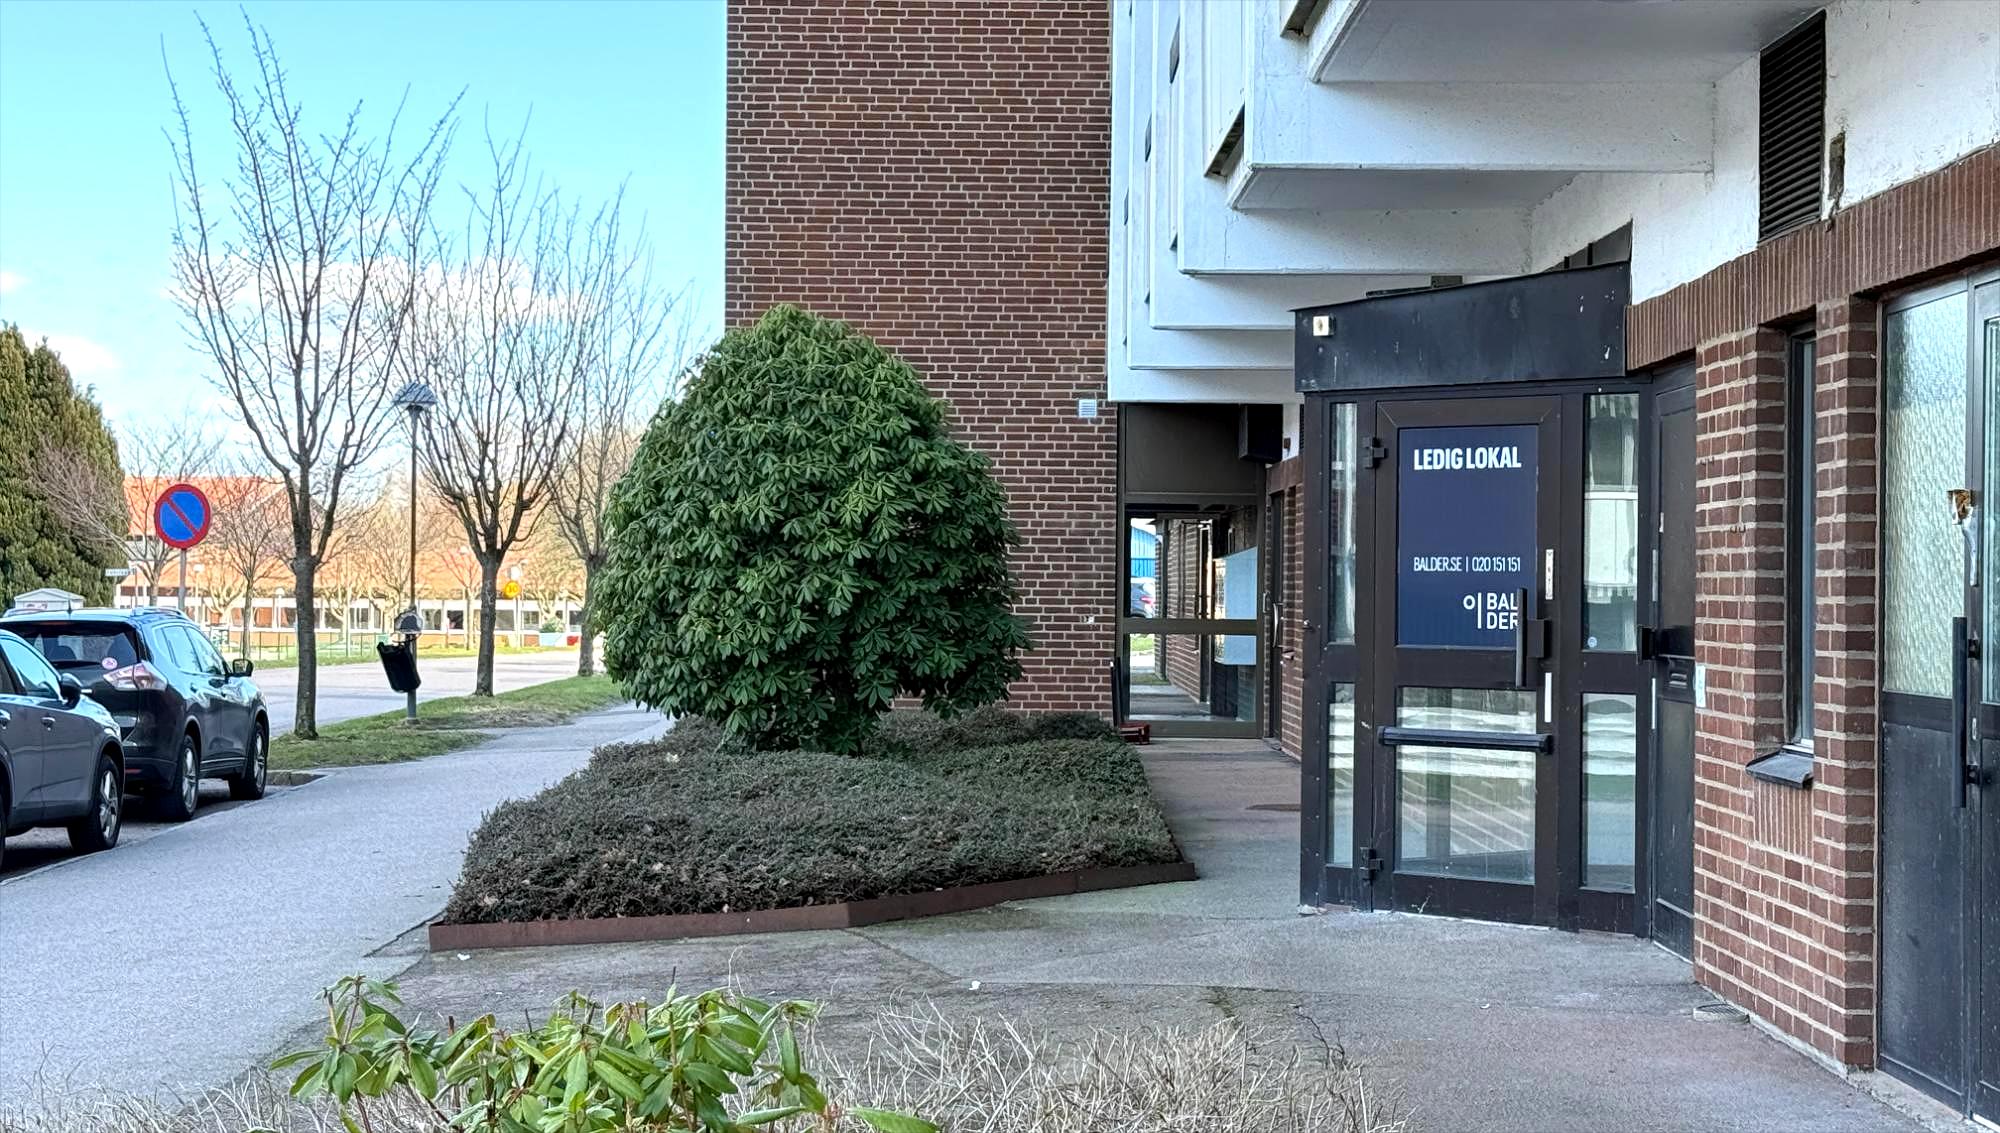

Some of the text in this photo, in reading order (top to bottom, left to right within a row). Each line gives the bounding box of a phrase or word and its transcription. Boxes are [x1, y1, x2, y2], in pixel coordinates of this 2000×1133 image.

[1414, 446, 1522, 470] LEDIG LOKAL
[1413, 556, 1520, 572] BALDER.SE 020 151 151
[1487, 592, 1519, 610] BAL
